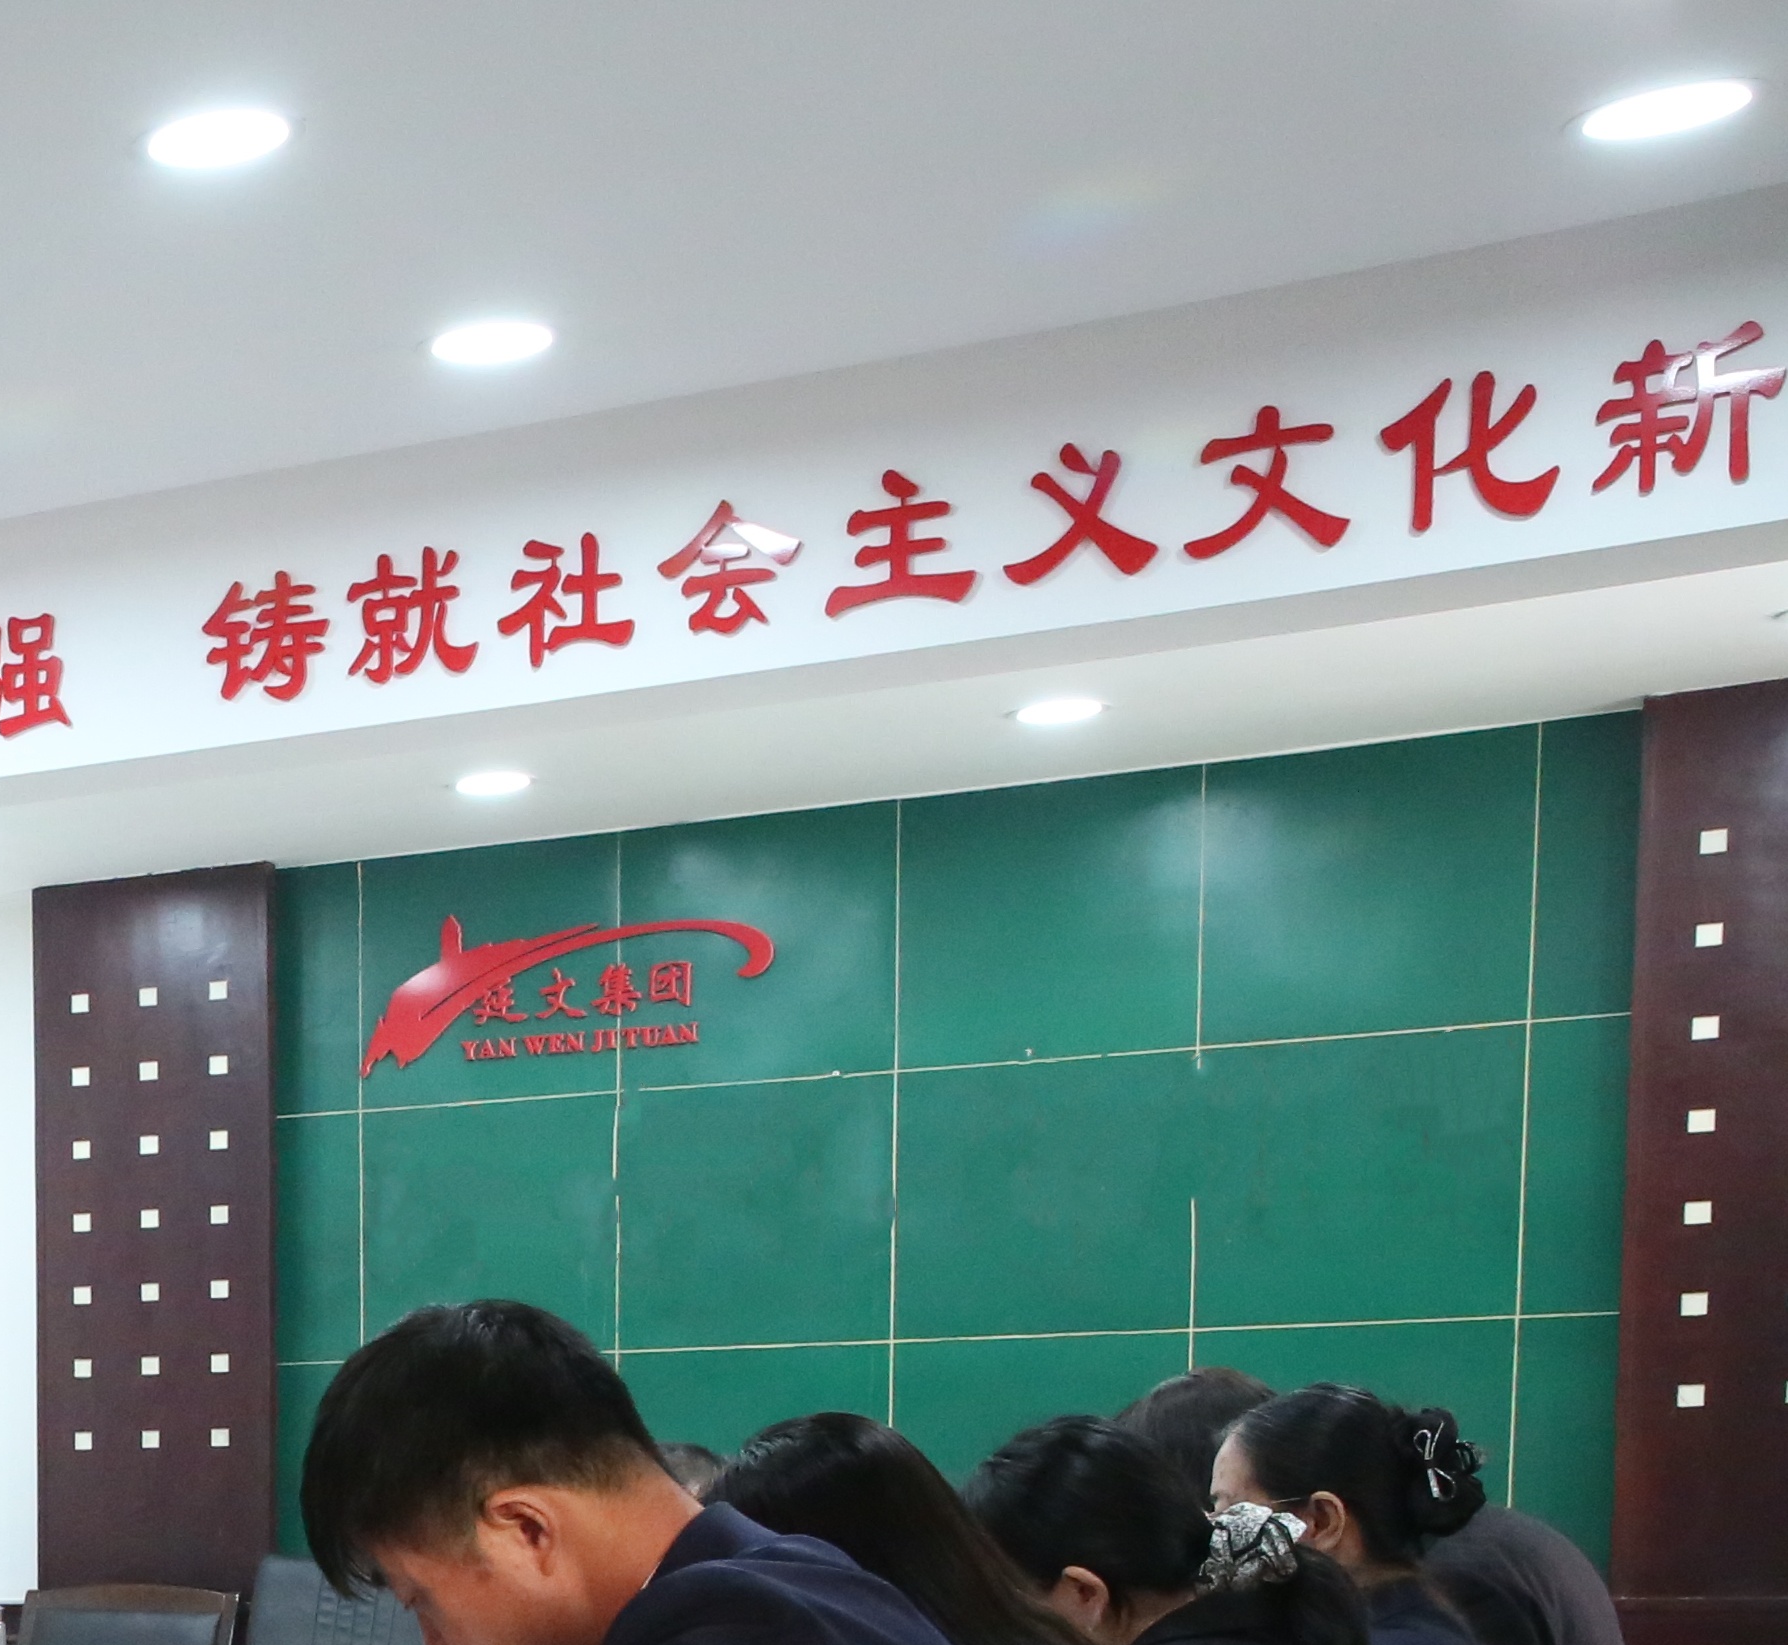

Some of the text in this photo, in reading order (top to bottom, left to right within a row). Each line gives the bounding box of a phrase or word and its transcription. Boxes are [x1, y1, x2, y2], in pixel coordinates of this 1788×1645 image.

[201, 320, 1788, 703] 铸就社会主义文化新
[462, 1038, 516, 1060] YAN
[523, 1032, 584, 1055] WEN
